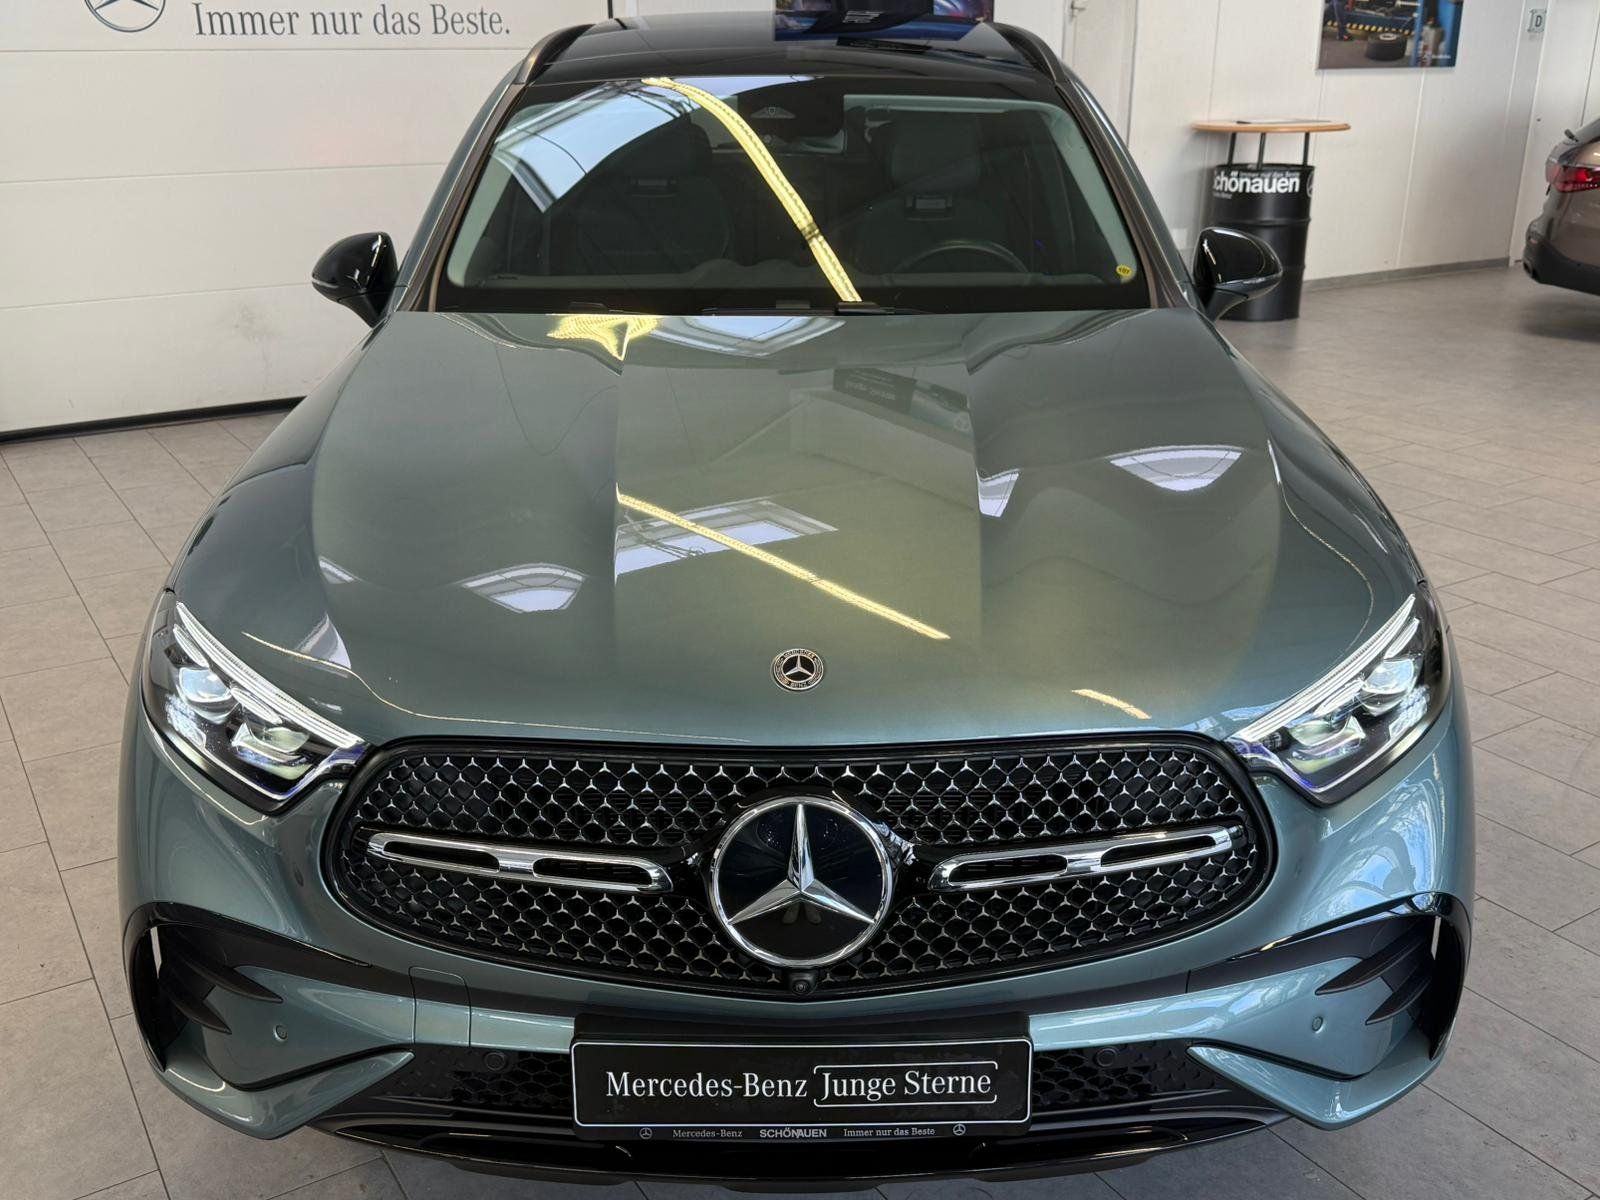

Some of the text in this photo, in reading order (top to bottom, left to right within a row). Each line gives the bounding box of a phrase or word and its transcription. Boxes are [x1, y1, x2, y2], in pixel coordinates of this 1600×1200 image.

[192, 2, 511, 36] Immer nur das Beste.
[1213, 170, 1300, 193] chönauen
[606, 1070, 992, 1101] Mercedes-Benz Junge Sterne
[672, 1127, 936, 1139] Mercedes-Benz SCHÖNAUEN Immer nur das Beste
